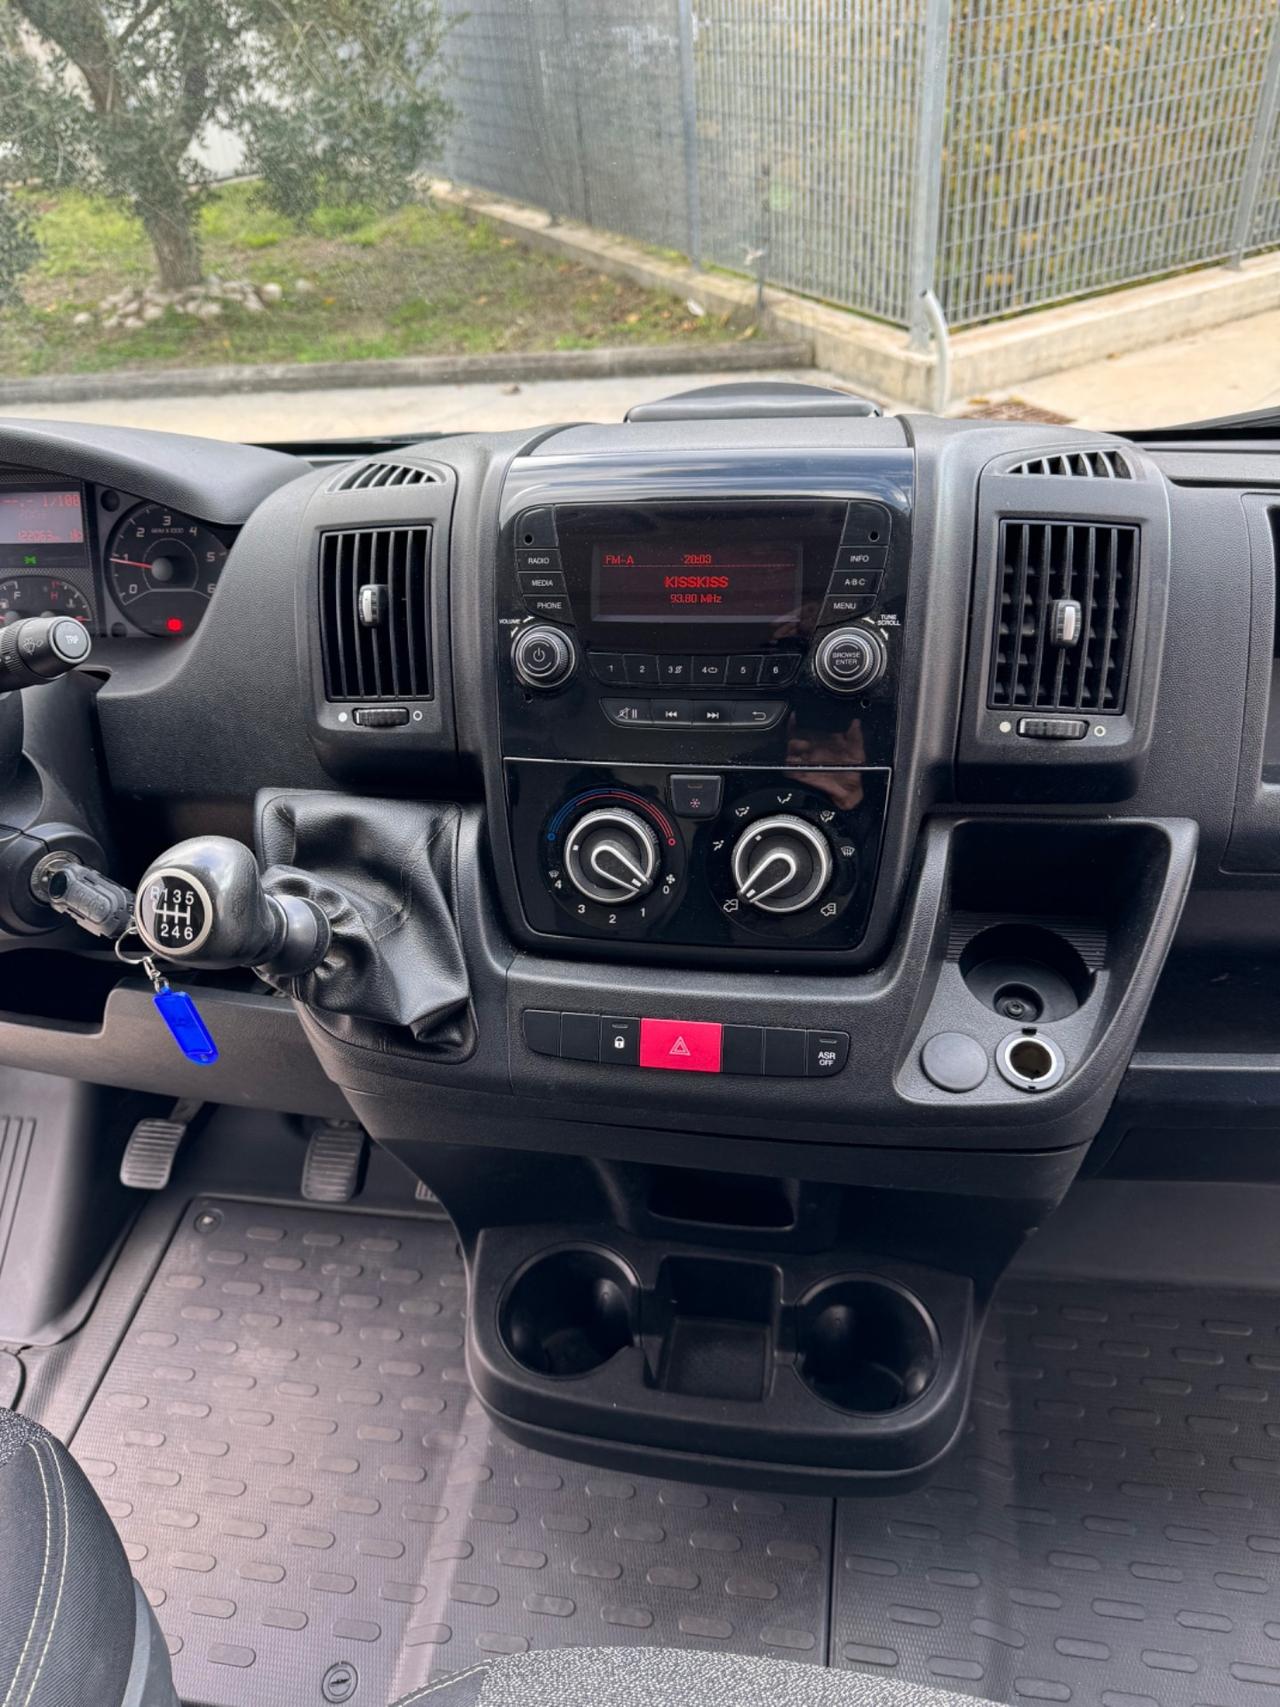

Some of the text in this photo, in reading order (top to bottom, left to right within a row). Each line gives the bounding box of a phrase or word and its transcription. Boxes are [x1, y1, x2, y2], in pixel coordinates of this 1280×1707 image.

[163, 515, 172, 526] 3
[136, 527, 145, 538] 2
[189, 526, 198, 536] 4
[206, 551, 216, 562] 5
[528, 557, 550, 565] RADIO
[605, 554, 712, 565] FM-A 20:03
[850, 555, 870, 563] INFO
[531, 579, 553, 587] MEDIA
[664, 575, 729, 588] KISSKISS
[129, 584, 138, 594] 0
[207, 583, 217, 594] 6
[13, 591, 21, 600] F
[670, 594, 722, 604] 93.80 MHz
[536, 602, 562, 610] PHONE
[833, 602, 857, 610] MENU
[832, 651, 861, 659] BROWSE
[609, 665, 614, 673] 1
[639, 665, 646, 673] 2
[667, 665, 673, 674] 3
[701, 666, 707, 674] 4
[740, 666, 746, 674] 5
[772, 666, 779, 674] 6
[554, 879, 562, 889] 4
[150, 886, 160, 900] R
[163, 888, 168, 901] 1
[662, 885, 670, 894] 0
[172, 889, 182, 903] 3
[185, 891, 194, 905] 5
[577, 904, 586, 914] 3
[640, 907, 646, 917] 1
[608, 914, 617, 924] 2
[160, 923, 169, 937] 2
[171, 925, 180, 939] 4
[183, 926, 193, 940] 6
[817, 1051, 836, 1060] ASR
[818, 1058, 835, 1067] OFF
